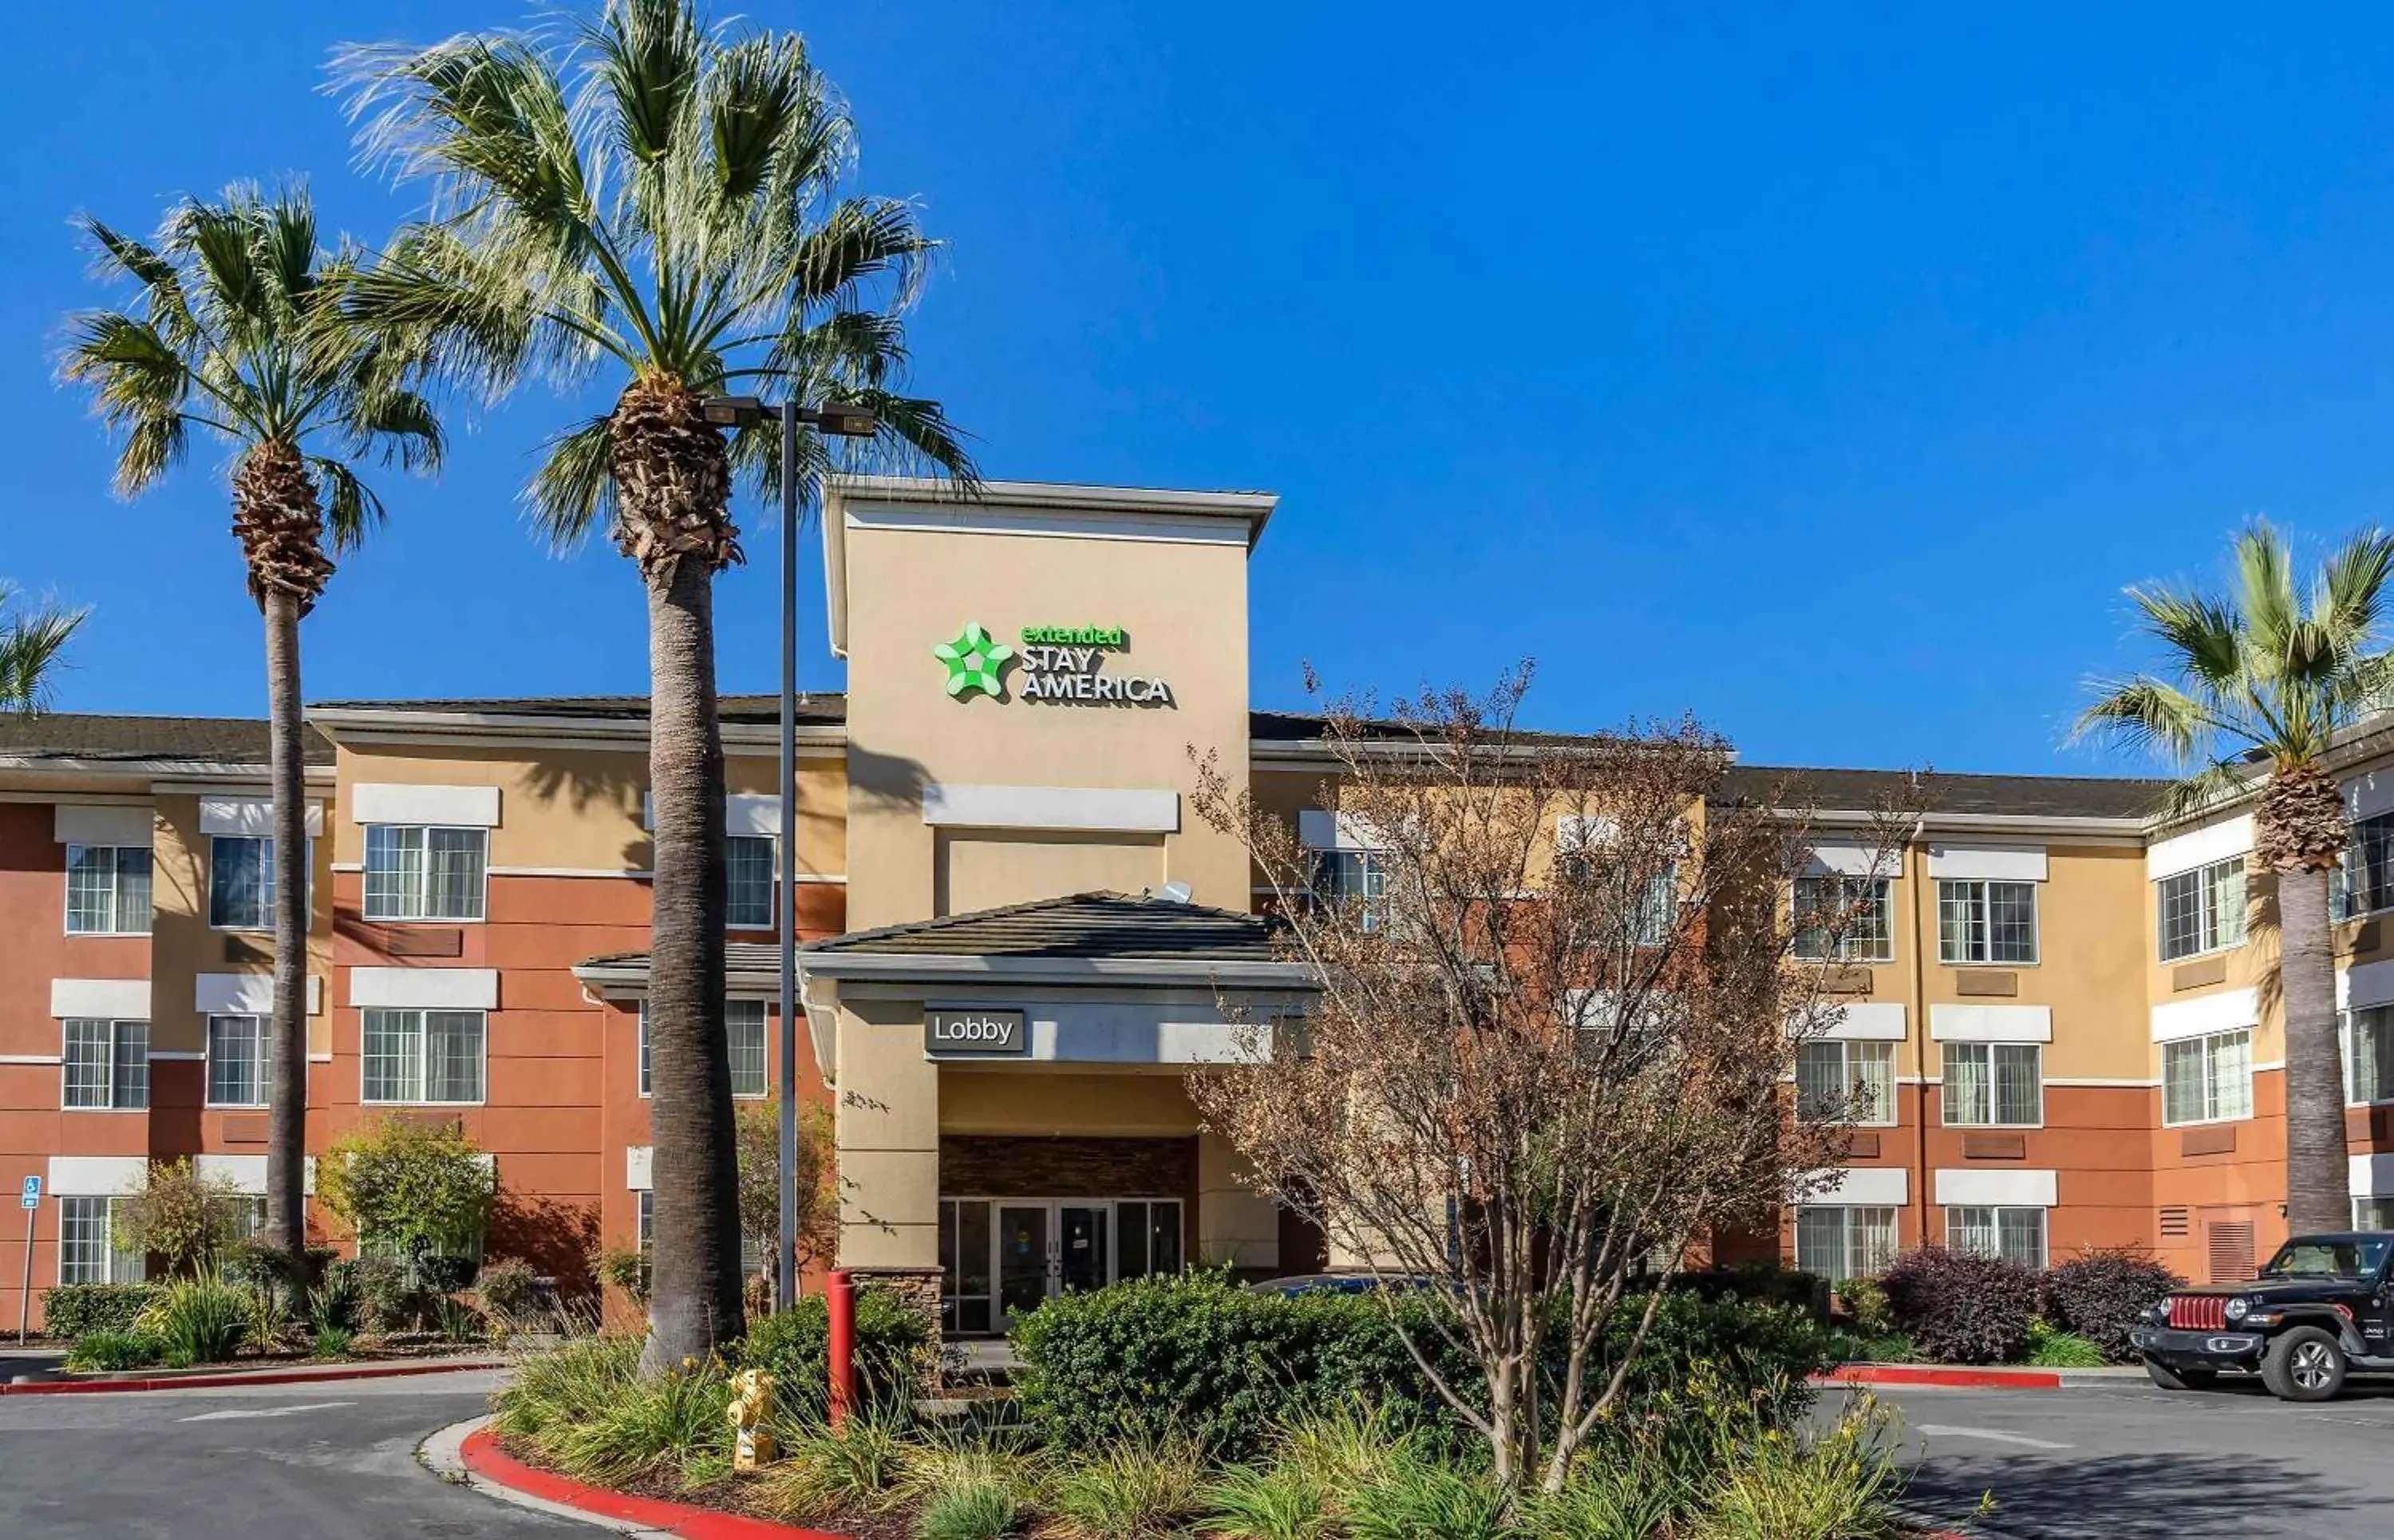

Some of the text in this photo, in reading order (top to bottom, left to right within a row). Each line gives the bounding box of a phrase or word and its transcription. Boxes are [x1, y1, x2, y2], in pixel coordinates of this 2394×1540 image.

[1021, 625, 1121, 645] extended
[1023, 646, 1096, 672] STAY
[1021, 673, 1168, 701] AMERICA
[934, 1016, 1013, 1044] Lobby
